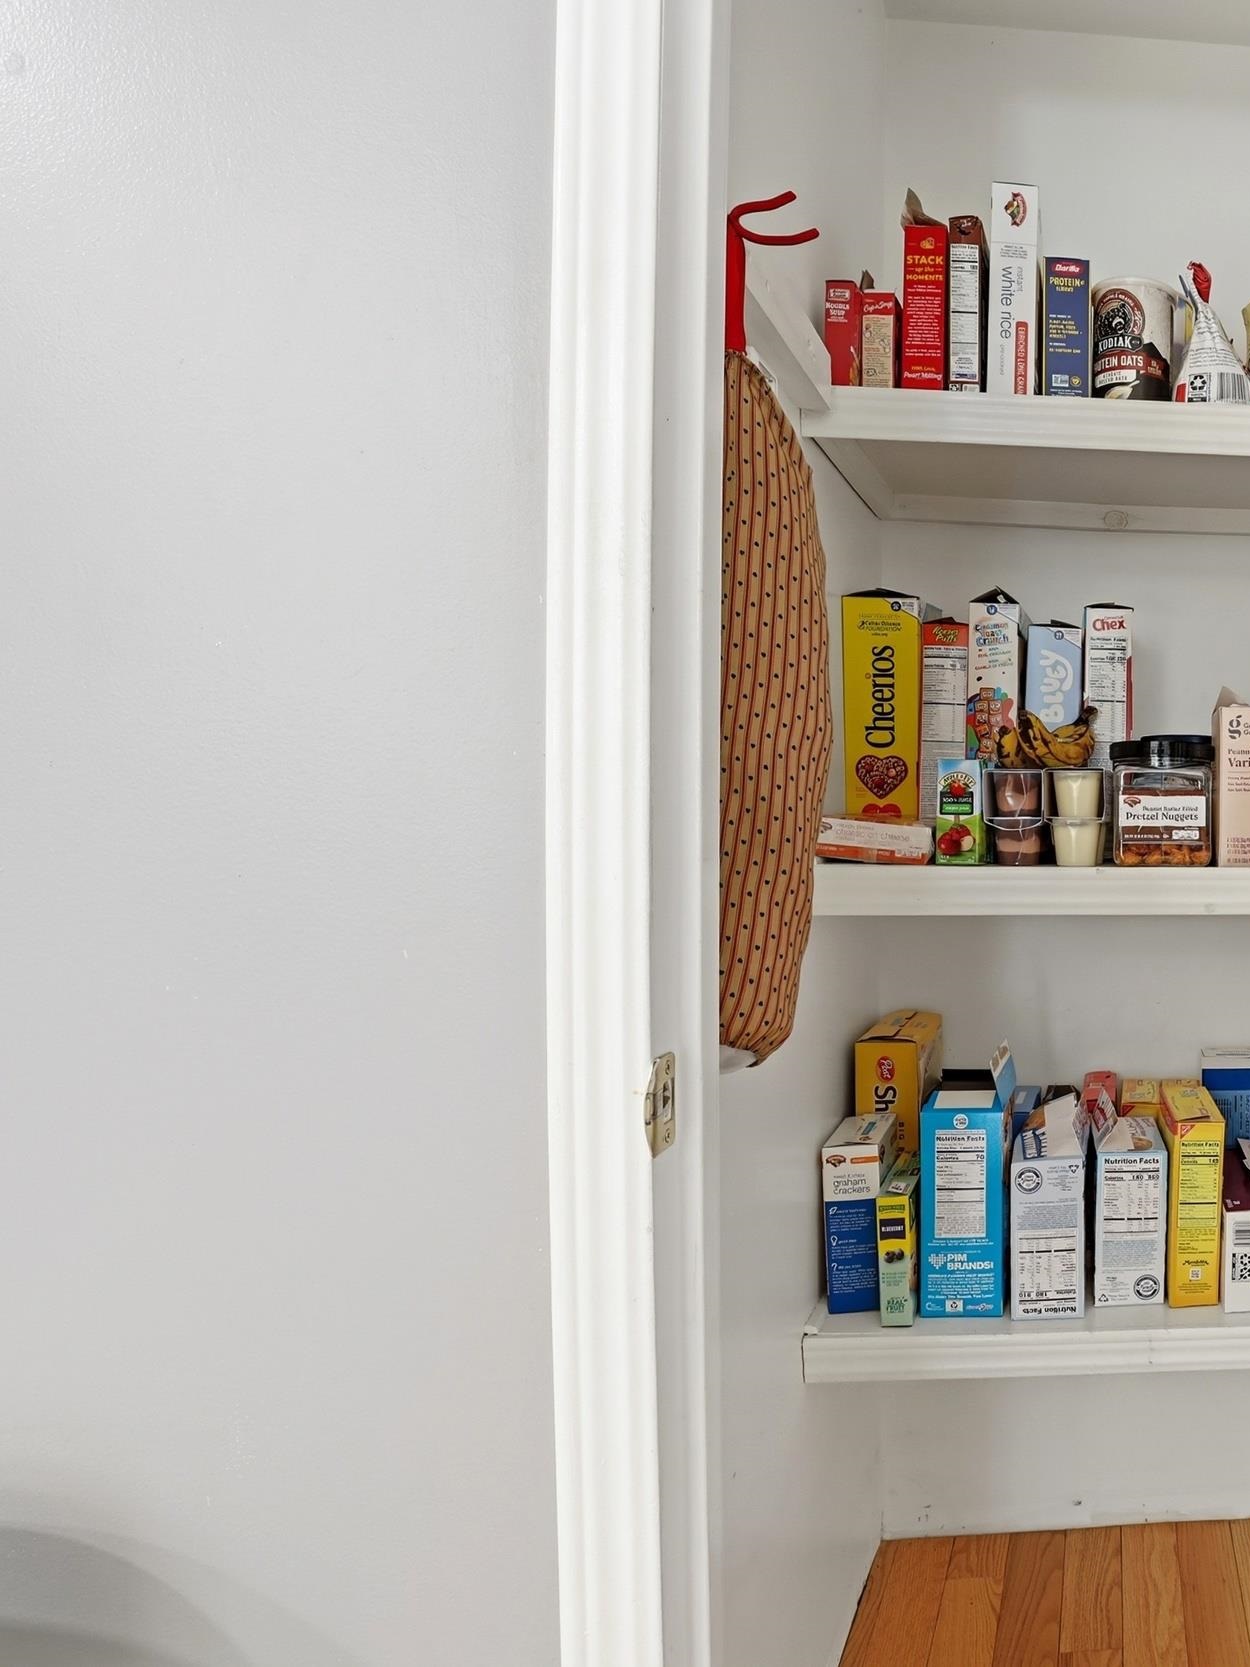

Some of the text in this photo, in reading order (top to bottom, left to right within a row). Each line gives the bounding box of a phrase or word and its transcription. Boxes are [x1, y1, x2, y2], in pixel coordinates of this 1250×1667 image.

[906, 255, 944, 265] STACK
[1055, 264, 1081, 273] Barilla
[1000, 266, 1016, 307] white
[1000, 311, 1016, 339] rice
[1098, 336, 1133, 354] KODIAK
[1120, 355, 1144, 368] OATS
[1092, 618, 1127, 632] Chex
[975, 633, 1009, 647] Crunch
[864, 644, 896, 749] Cheerios
[1126, 812, 1199, 822] Pretzel Nuggets
[880, 1059, 893, 1079] Post
[1104, 1157, 1138, 1165] Nutrition
[833, 1178, 867, 1188] graham
[833, 1186, 871, 1195] crackers
[947, 1253, 968, 1262] PIM
[1044, 1305, 1077, 1314] Nutrition
